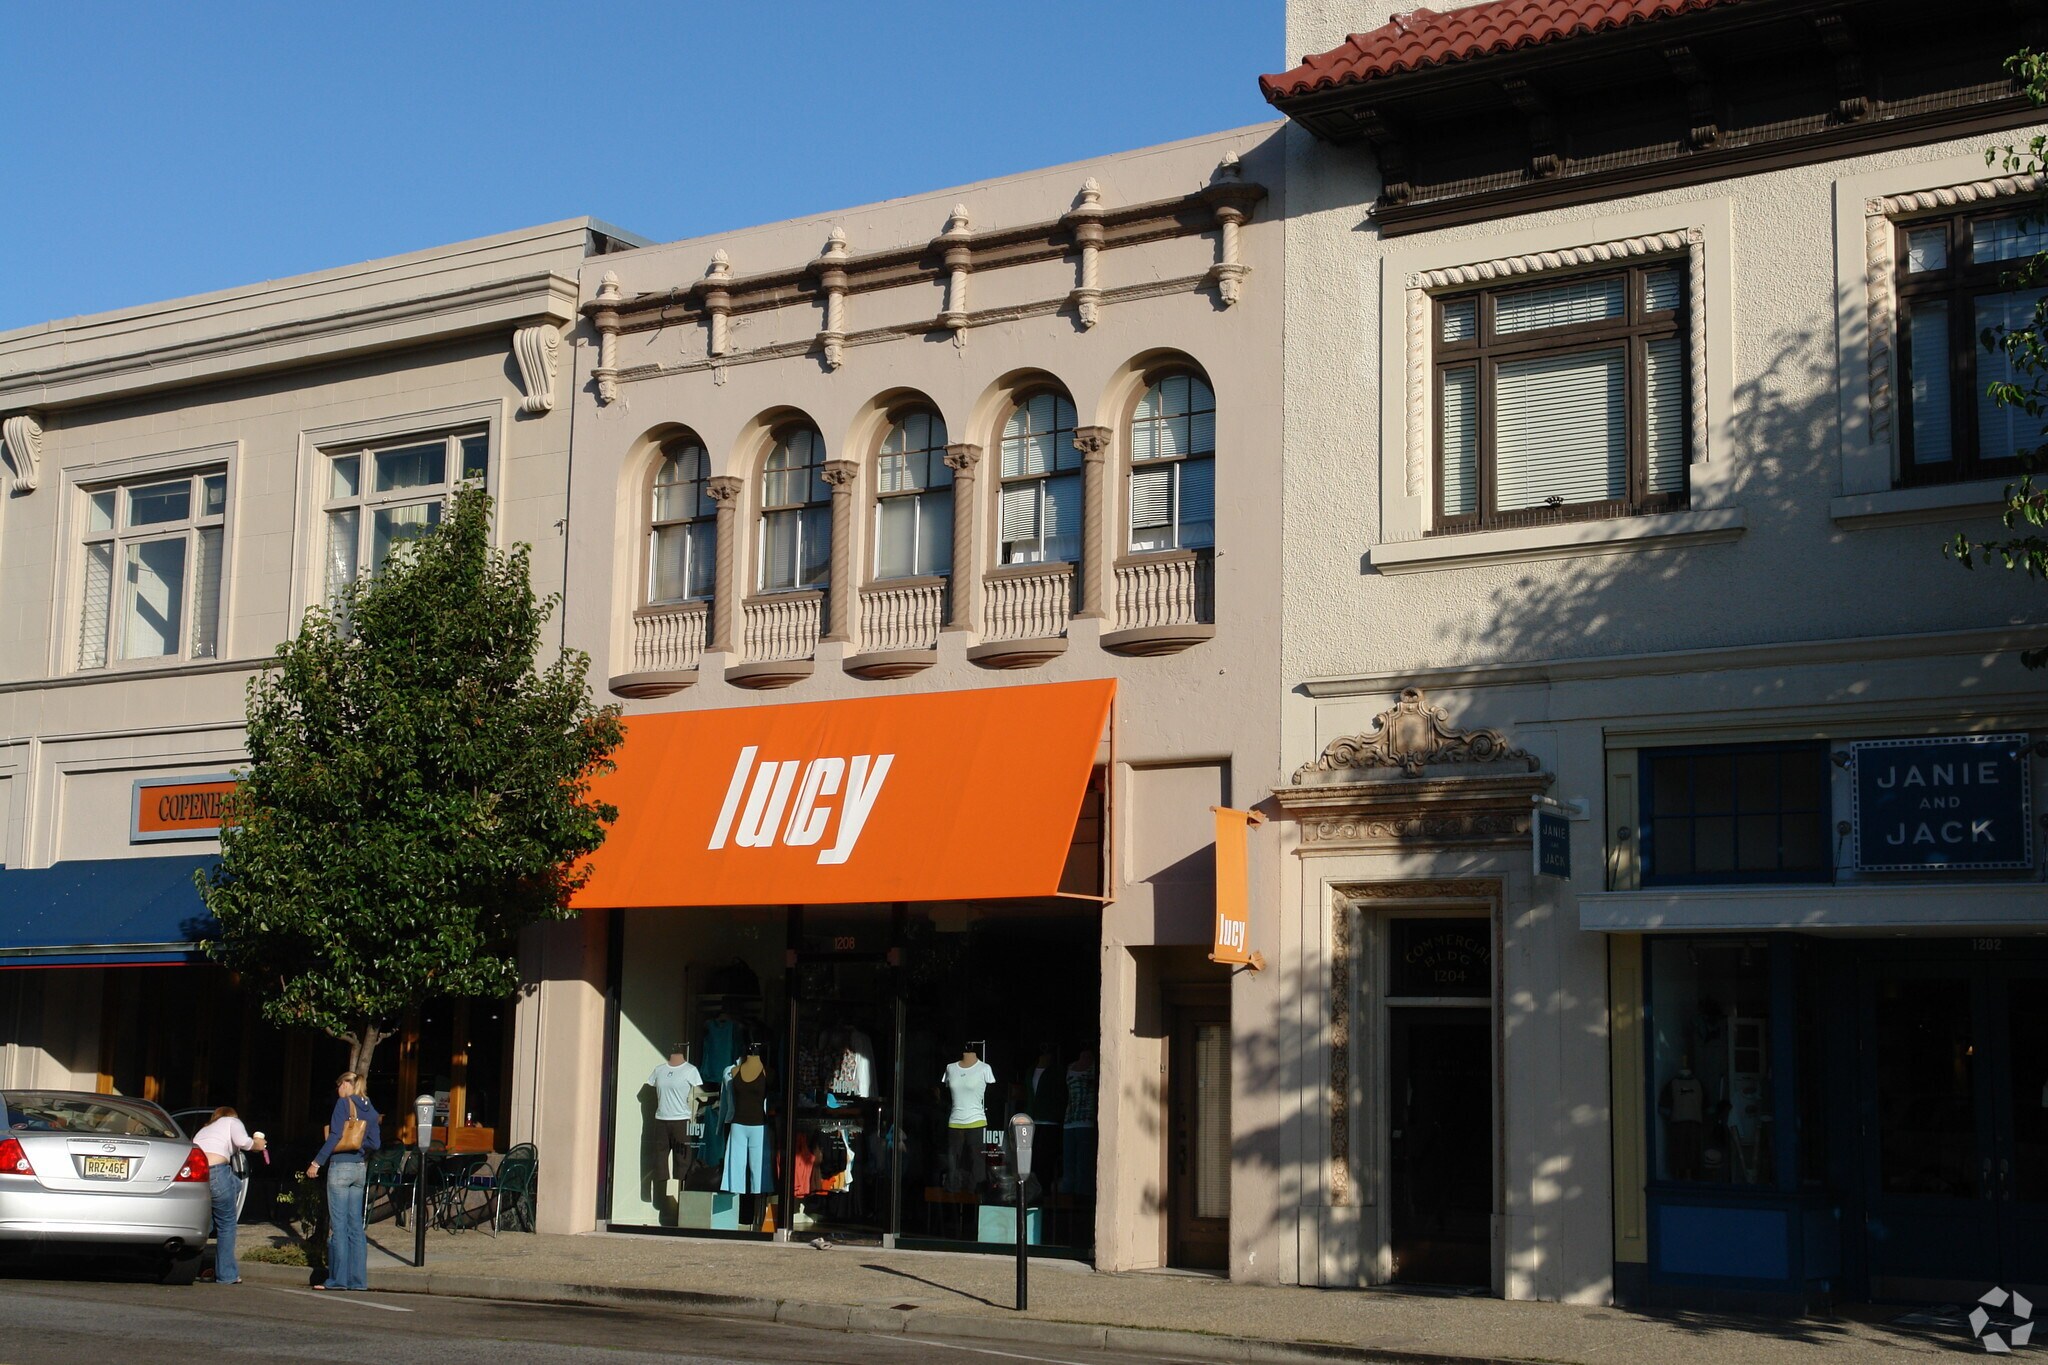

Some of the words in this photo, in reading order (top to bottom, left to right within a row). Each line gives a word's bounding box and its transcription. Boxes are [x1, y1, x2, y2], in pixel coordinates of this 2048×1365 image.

[1876, 761, 2000, 789] JANIE
[707, 745, 896, 865] lucy
[1919, 796, 1961, 810] AND
[1543, 823, 1566, 840] JANIE
[1886, 819, 1997, 846] JACK
[1544, 852, 1566, 868] JACK
[1218, 913, 1246, 953] lucy
[834, 936, 856, 950] 1208
[1972, 938, 2002, 951] 1202
[1434, 969, 1467, 982] 1204
[686, 1120, 706, 1139] lucy
[982, 1127, 1005, 1147] lucy
